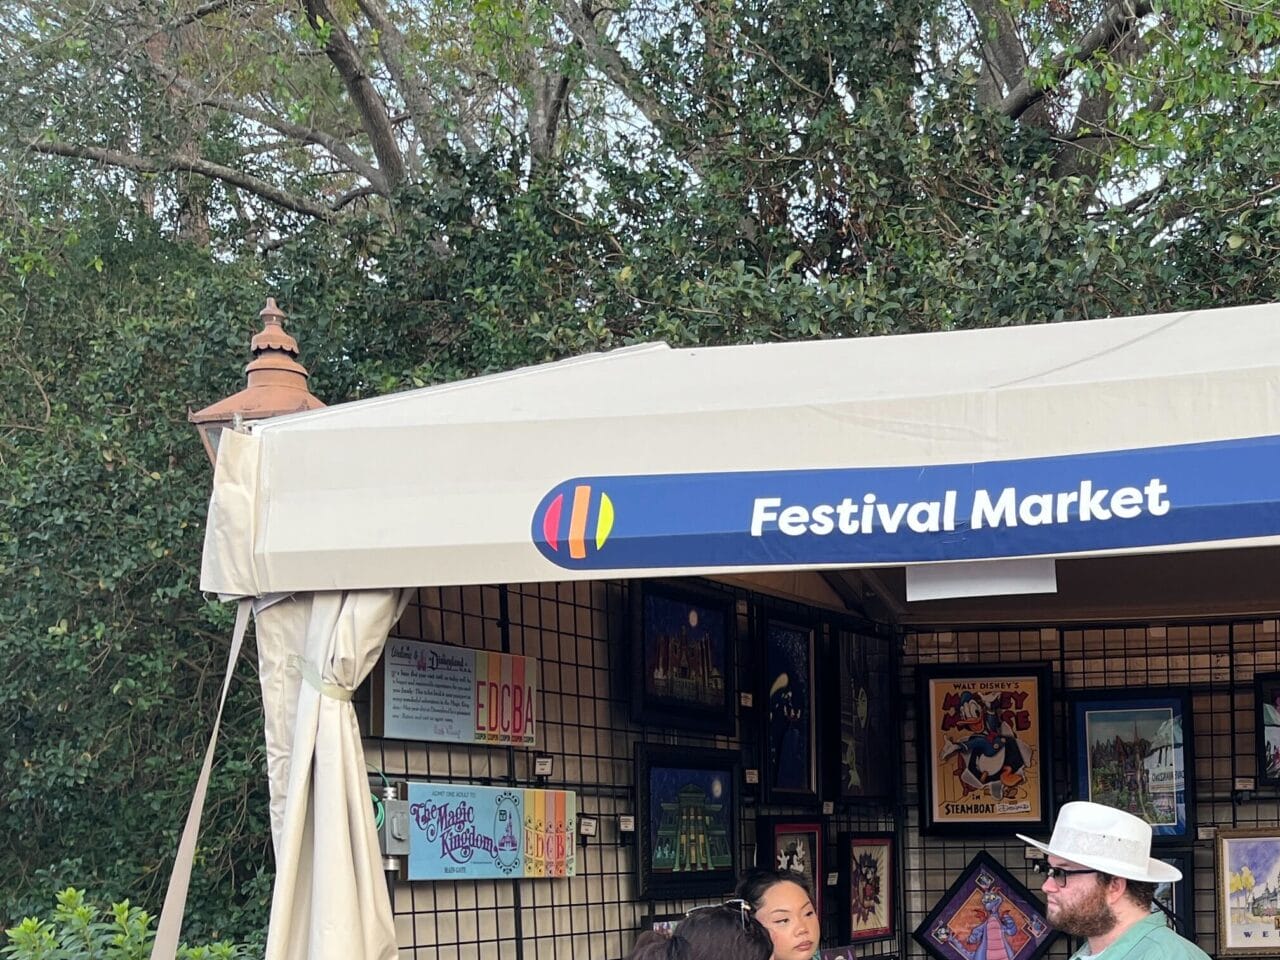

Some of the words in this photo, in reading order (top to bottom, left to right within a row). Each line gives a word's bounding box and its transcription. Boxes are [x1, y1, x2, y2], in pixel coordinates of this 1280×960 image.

[751, 490, 957, 537] Festival
[971, 478, 1171, 530] Market
[428, 801, 474, 841] Magic
[945, 803, 996, 815] STEAMBOAT
[440, 826, 498, 864] Kingdom
